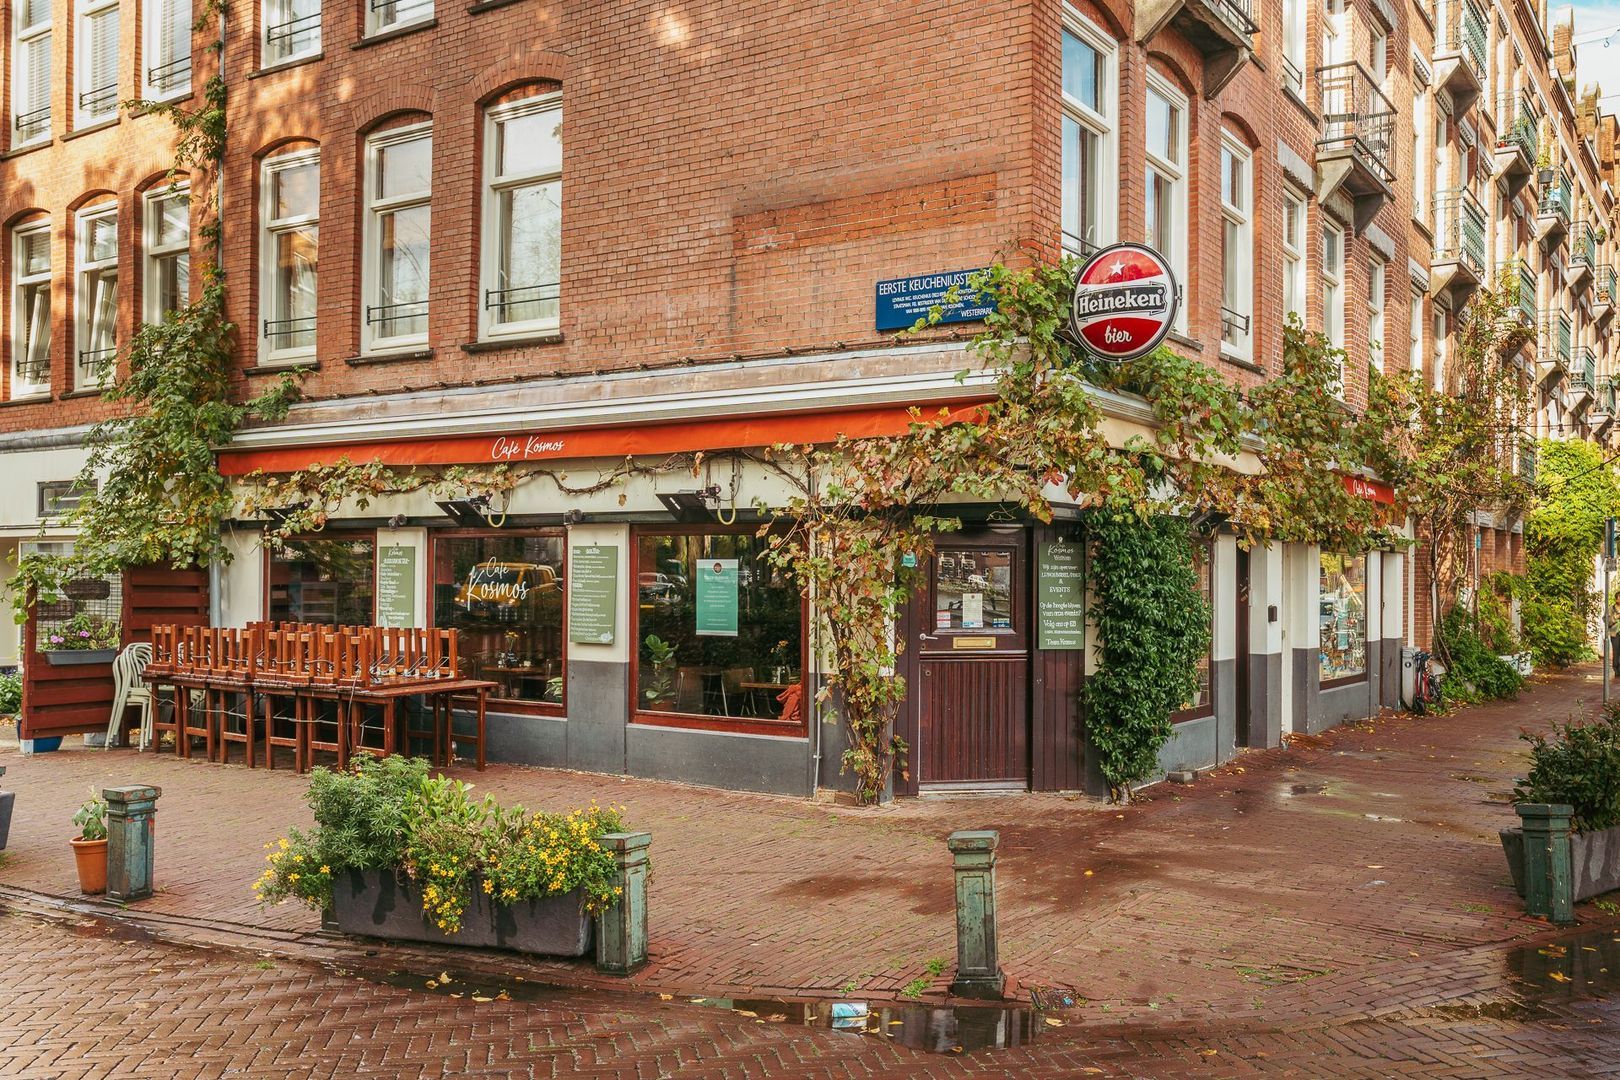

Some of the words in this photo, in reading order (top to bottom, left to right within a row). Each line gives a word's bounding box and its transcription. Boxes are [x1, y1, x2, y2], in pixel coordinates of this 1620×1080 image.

[879, 281, 907, 296] EERSTE
[1078, 290, 1162, 315] Heineken
[961, 307, 993, 318] WESTERPARK
[1104, 325, 1132, 344] bier
[524, 435, 566, 459] Kosmos
[1048, 544, 1074, 556] Kosmos
[466, 565, 531, 612] Kosmos
[1043, 620, 1055, 629] Volg
